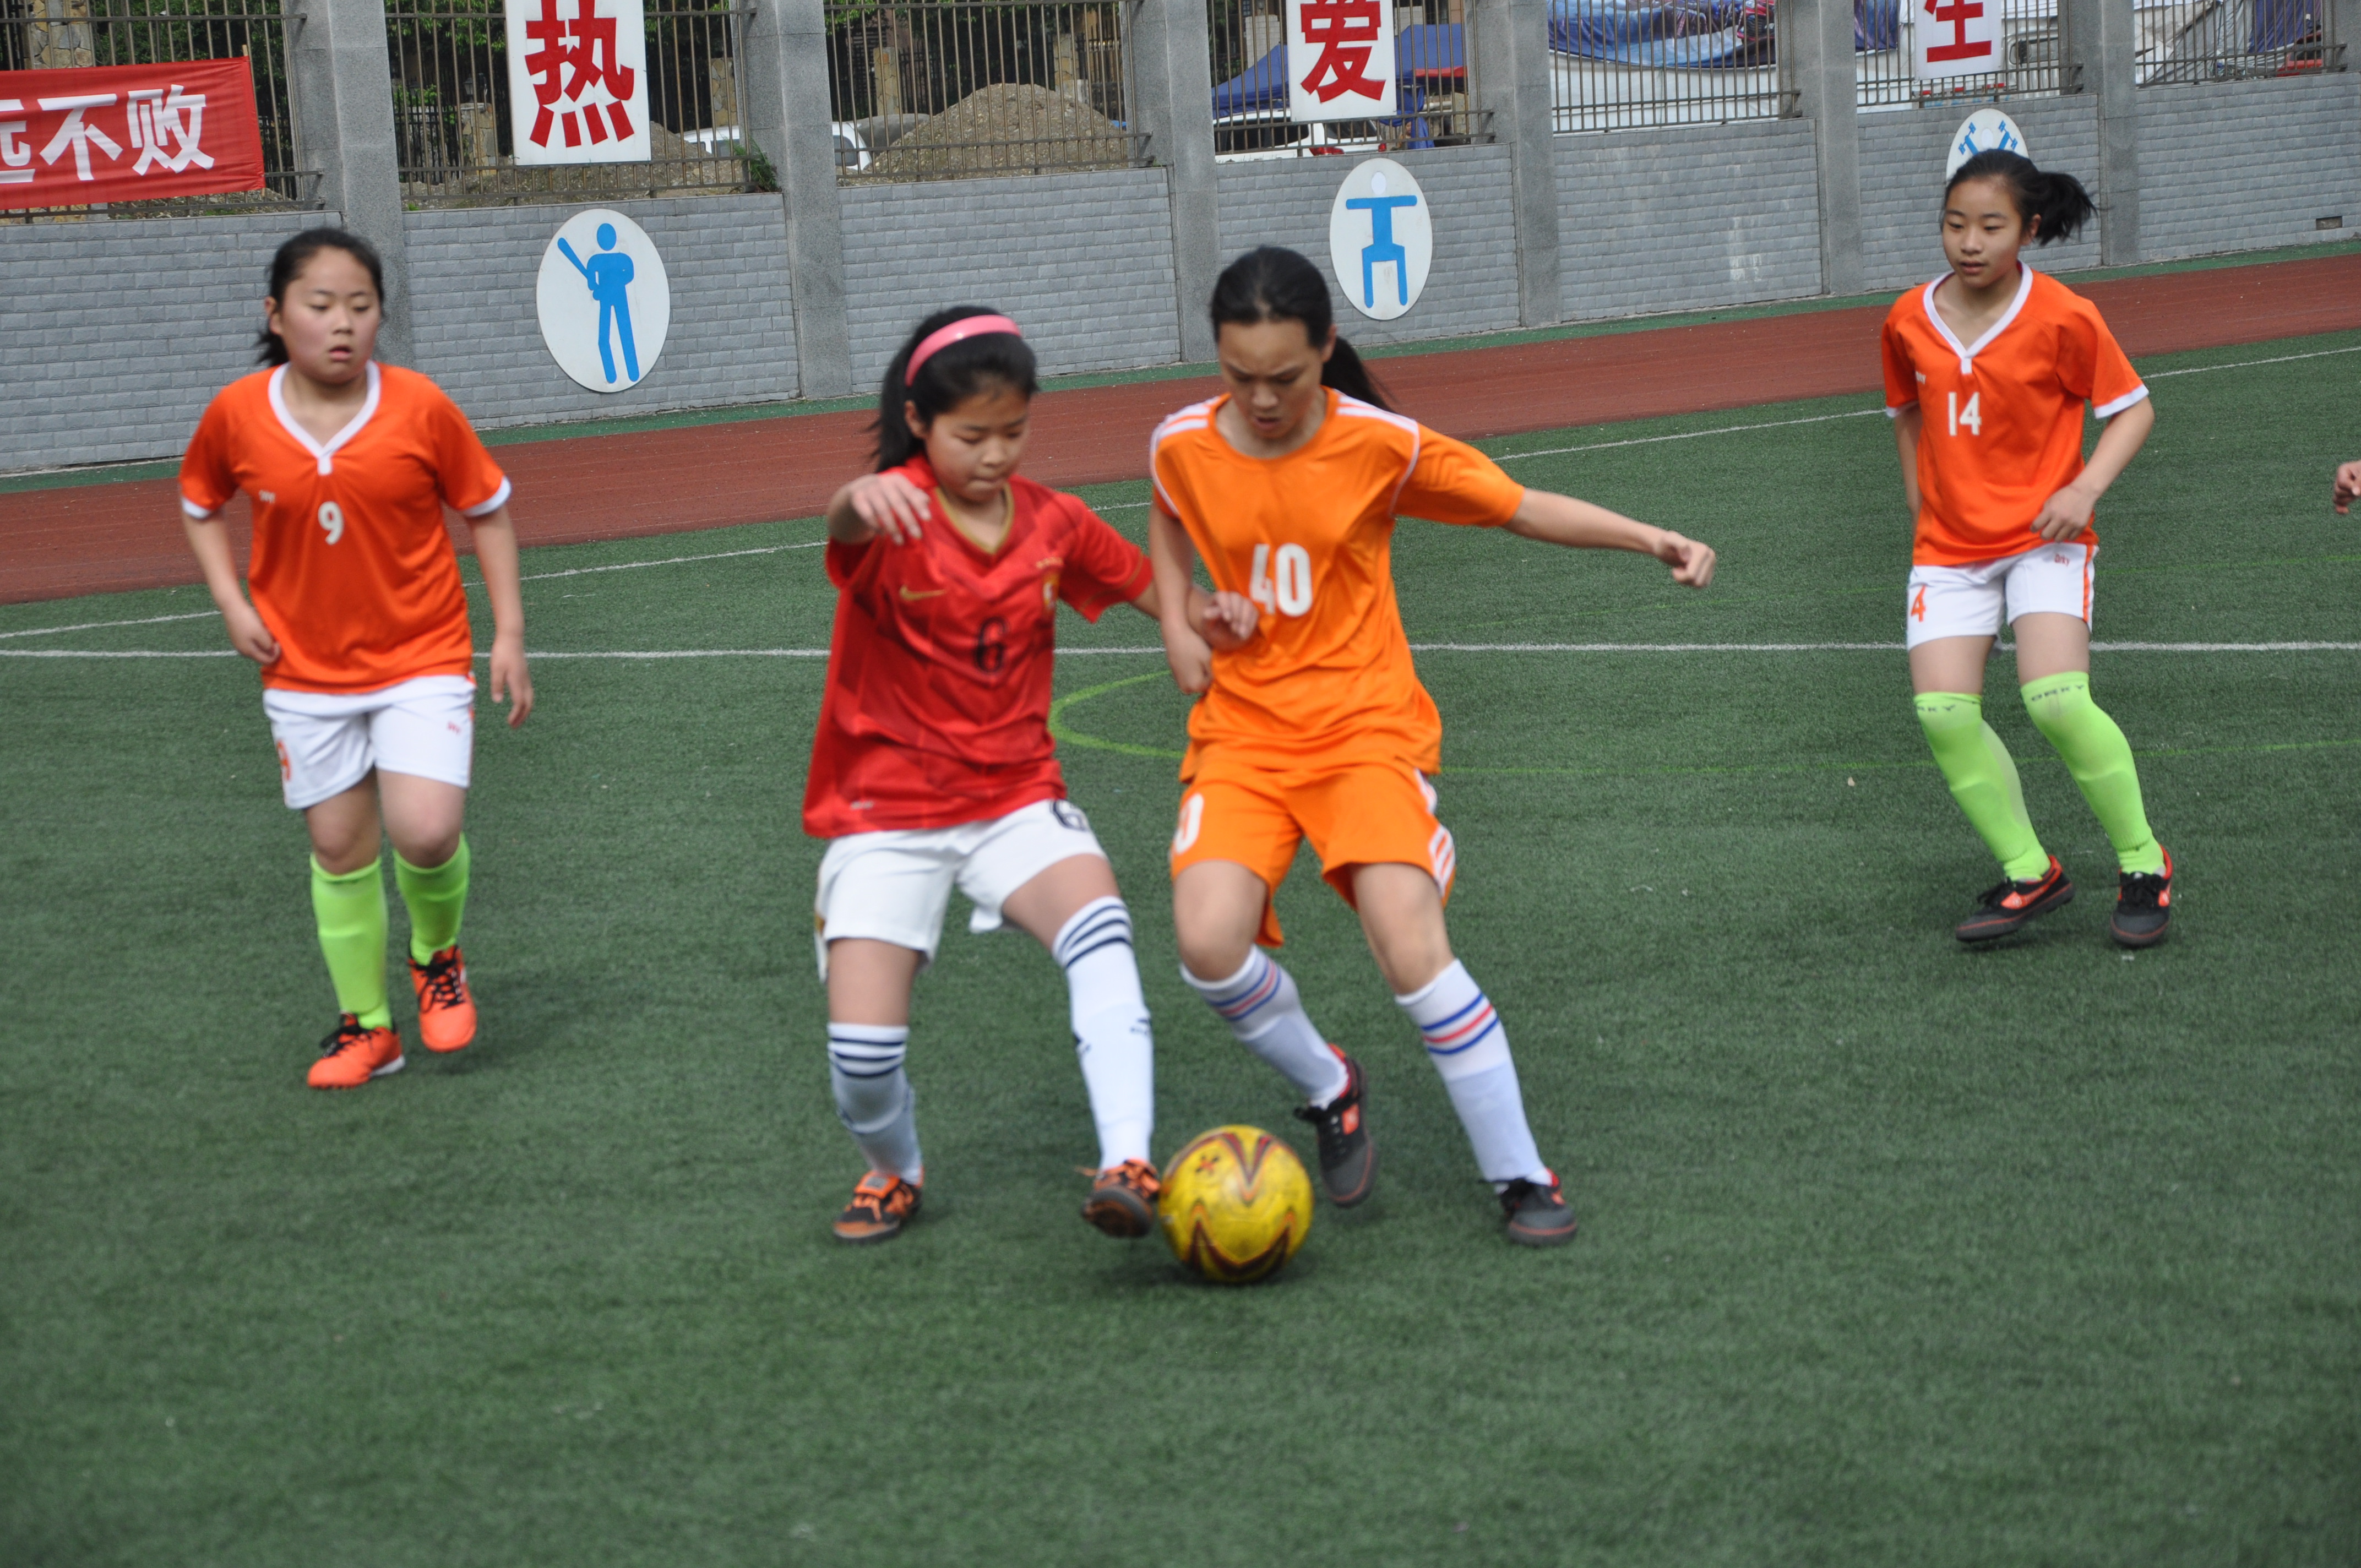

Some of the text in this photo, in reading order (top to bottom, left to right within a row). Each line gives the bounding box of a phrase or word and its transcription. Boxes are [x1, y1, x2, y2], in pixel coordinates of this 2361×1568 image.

[524, 0, 635, 148] 热
[1300, 0, 1386, 104] 爱
[1948, 391, 1982, 437] 14
[317, 500, 344, 546] 9
[1249, 542, 1313, 617] 40
[973, 615, 1009, 675] 6
